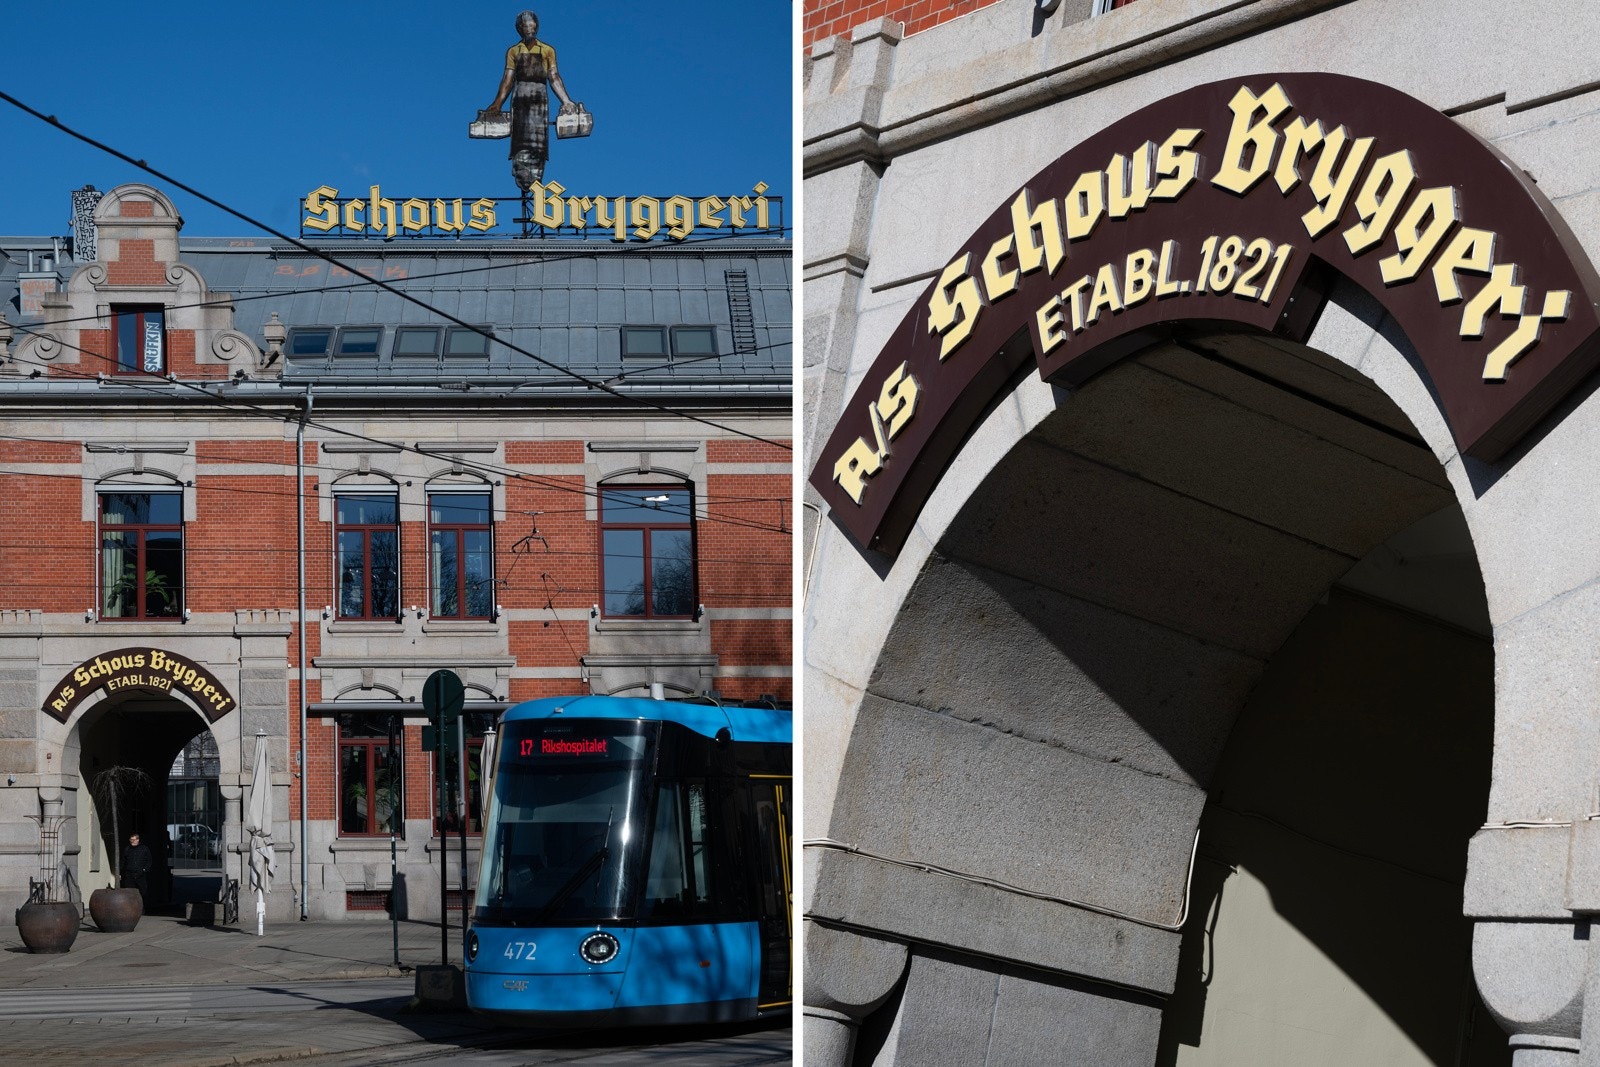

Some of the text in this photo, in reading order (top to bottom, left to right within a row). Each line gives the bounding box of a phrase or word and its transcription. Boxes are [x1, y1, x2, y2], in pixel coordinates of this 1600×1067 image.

[303, 180, 770, 241] Schous Bryggeri
[832, 82, 1572, 505] A/S Schous Bryggeri
[51, 649, 231, 712] A/S Schous Bryggeri
[520, 738, 608, 757] 17 Rikshospitalet
[504, 942, 538, 961] 472
